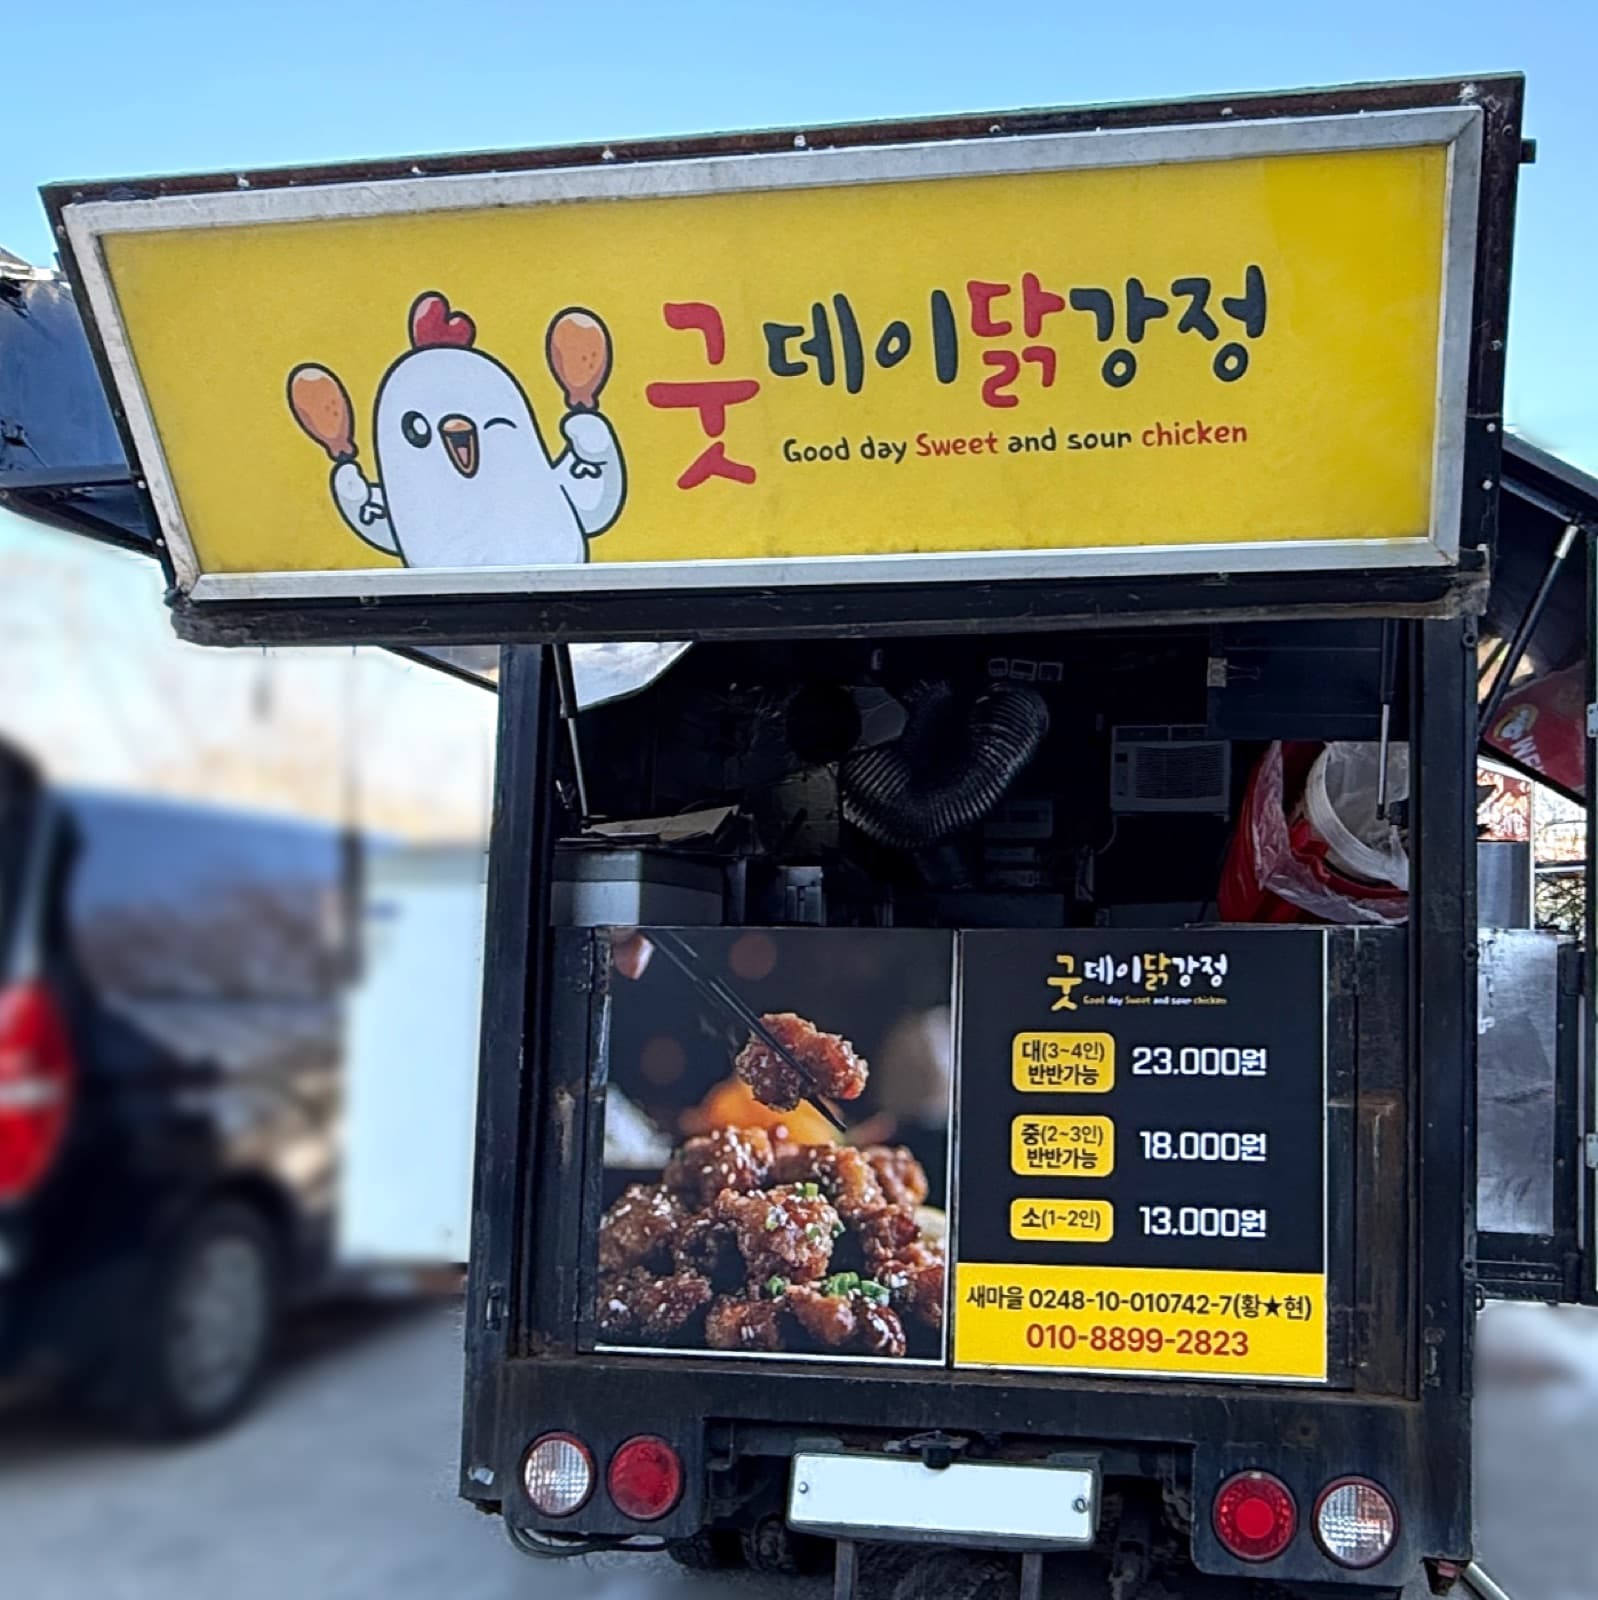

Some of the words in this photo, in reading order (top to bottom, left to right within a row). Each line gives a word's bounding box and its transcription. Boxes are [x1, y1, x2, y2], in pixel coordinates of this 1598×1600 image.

[646, 264, 1267, 490] 굿데이닭강정
[784, 437, 850, 462] Good
[861, 436, 906, 464] day
[917, 432, 997, 456] Sweet
[1008, 427, 1056, 453] and
[1068, 433, 1131, 449] sour
[1143, 421, 1246, 446] chicken
[1046, 952, 1228, 1011] 굿데이닭강정
[1022, 1040, 1104, 1062] 대(3~4인)
[1133, 1047, 1266, 1076] 23.000원
[1029, 1064, 1099, 1085] 반반가능
[1021, 1124, 1103, 1146] 중(2~3인)
[1140, 1131, 1266, 1161] 18.000원
[1027, 1147, 1098, 1169] 반반가능
[1021, 1208, 1100, 1231] 소(1~2인)
[1139, 1206, 1266, 1237] 13.000원
[967, 1286, 1024, 1309] 새마을
[1027, 1324, 1248, 1356] 010-8899-2823
